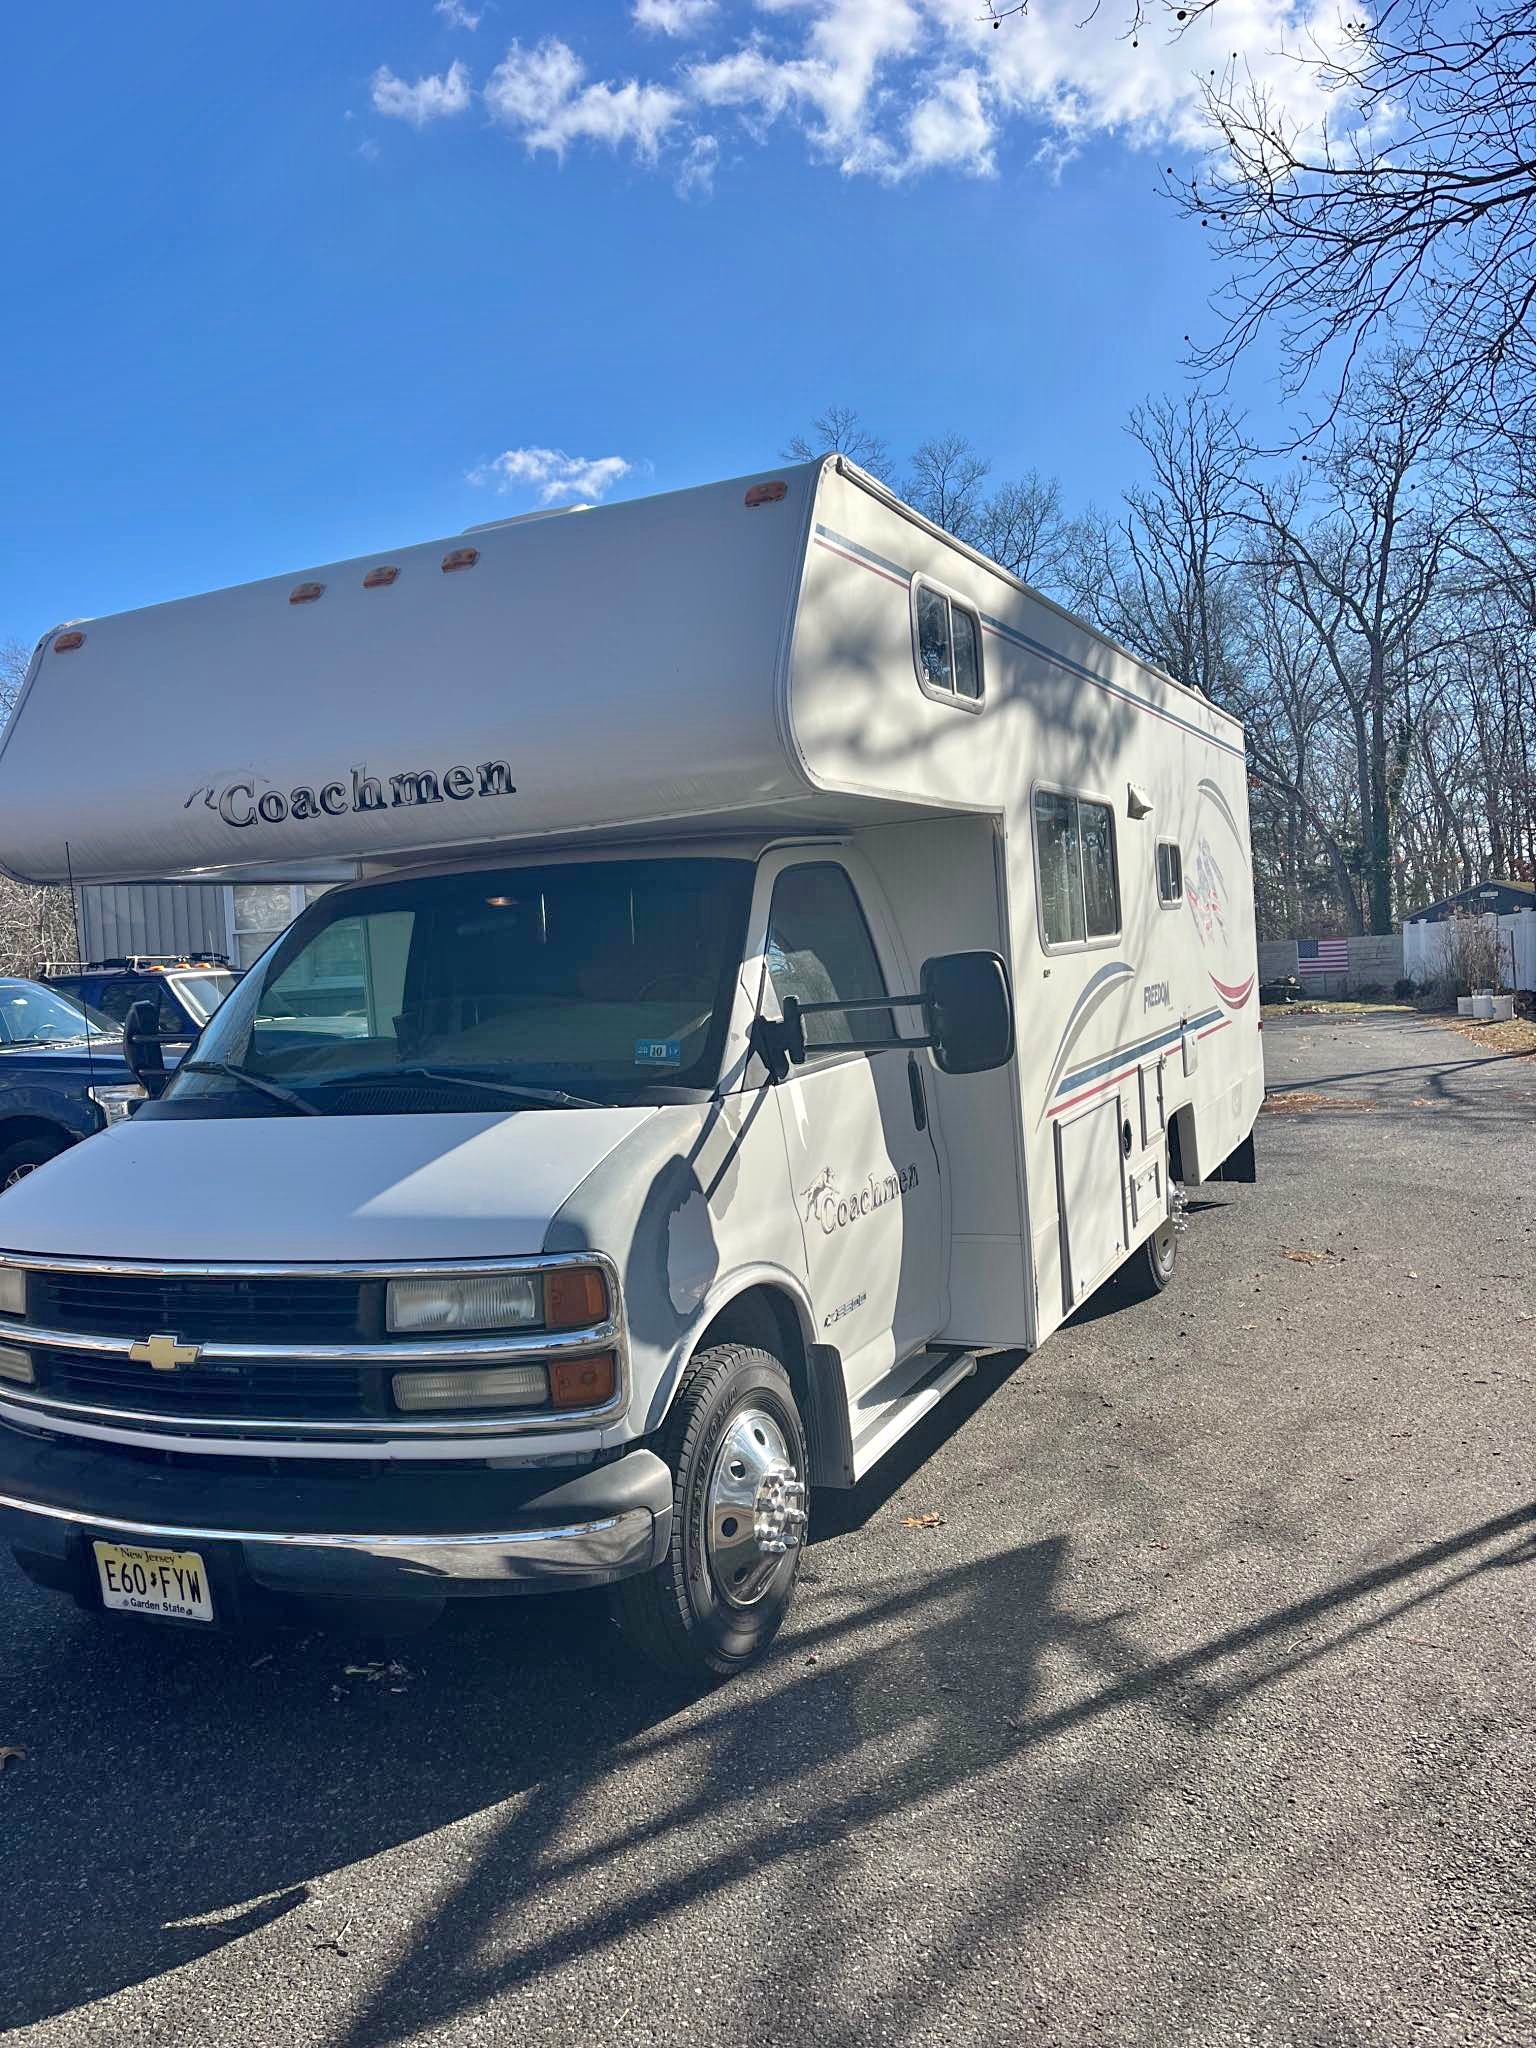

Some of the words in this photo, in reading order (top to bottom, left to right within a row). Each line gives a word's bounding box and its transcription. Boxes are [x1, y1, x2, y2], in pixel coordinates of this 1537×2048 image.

[218, 759, 517, 828] Coachmen
[1144, 980, 1171, 1014] FREEDOM
[820, 1162, 919, 1235] Coachmen
[120, 1547, 143, 1560] New
[144, 1551, 175, 1565] Jersey
[104, 1559, 147, 1595] E60
[158, 1566, 201, 1603] FYW
[130, 1597, 160, 1610] Garden
[162, 1601, 185, 1613] State
